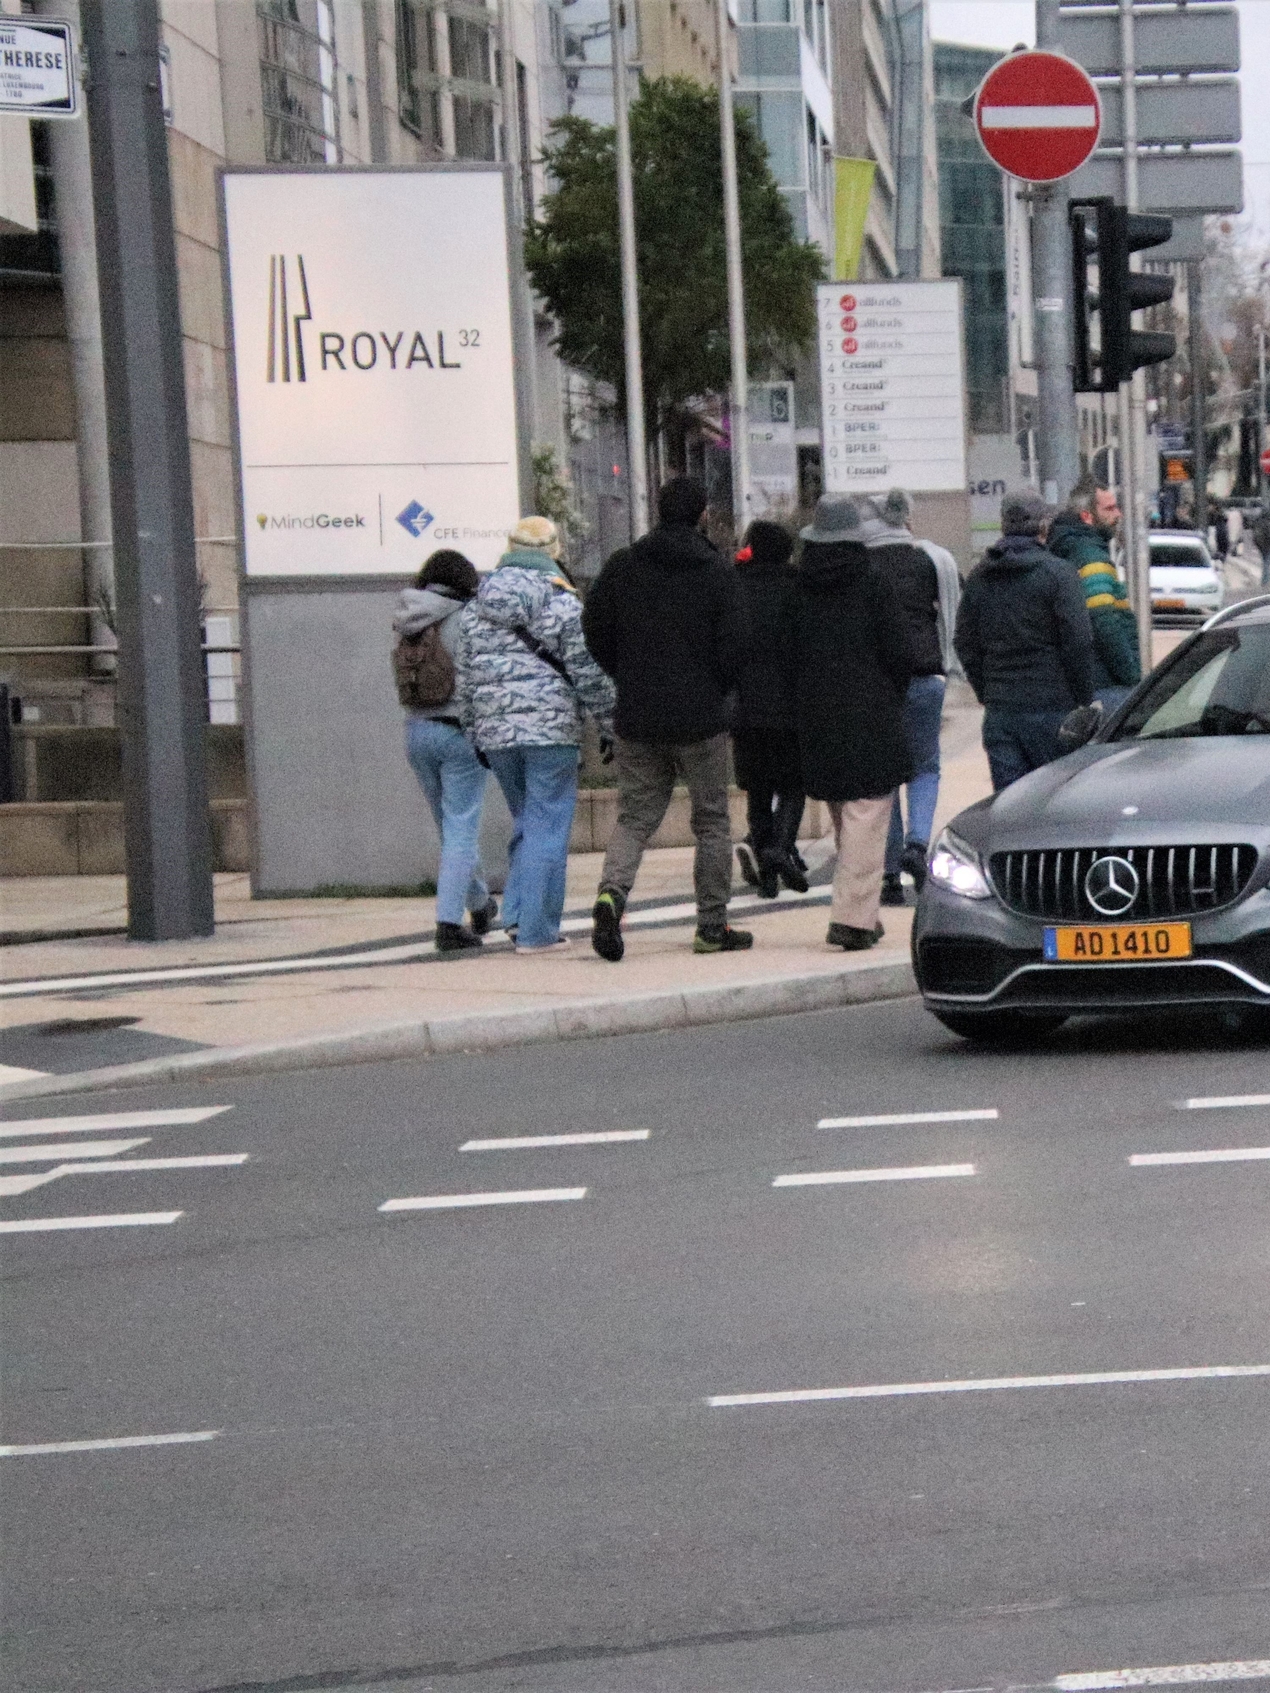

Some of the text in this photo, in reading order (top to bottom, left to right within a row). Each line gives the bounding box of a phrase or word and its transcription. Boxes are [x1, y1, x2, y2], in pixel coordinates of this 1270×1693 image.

[0, 50, 62, 69] HERESE
[320, 330, 461, 370] ROYAL
[829, 404, 836, 416] 2
[271, 514, 365, 529] MindGeek
[433, 528, 459, 539] CFE
[1075, 932, 1103, 955] AD
[1111, 930, 1170, 954] 1410
